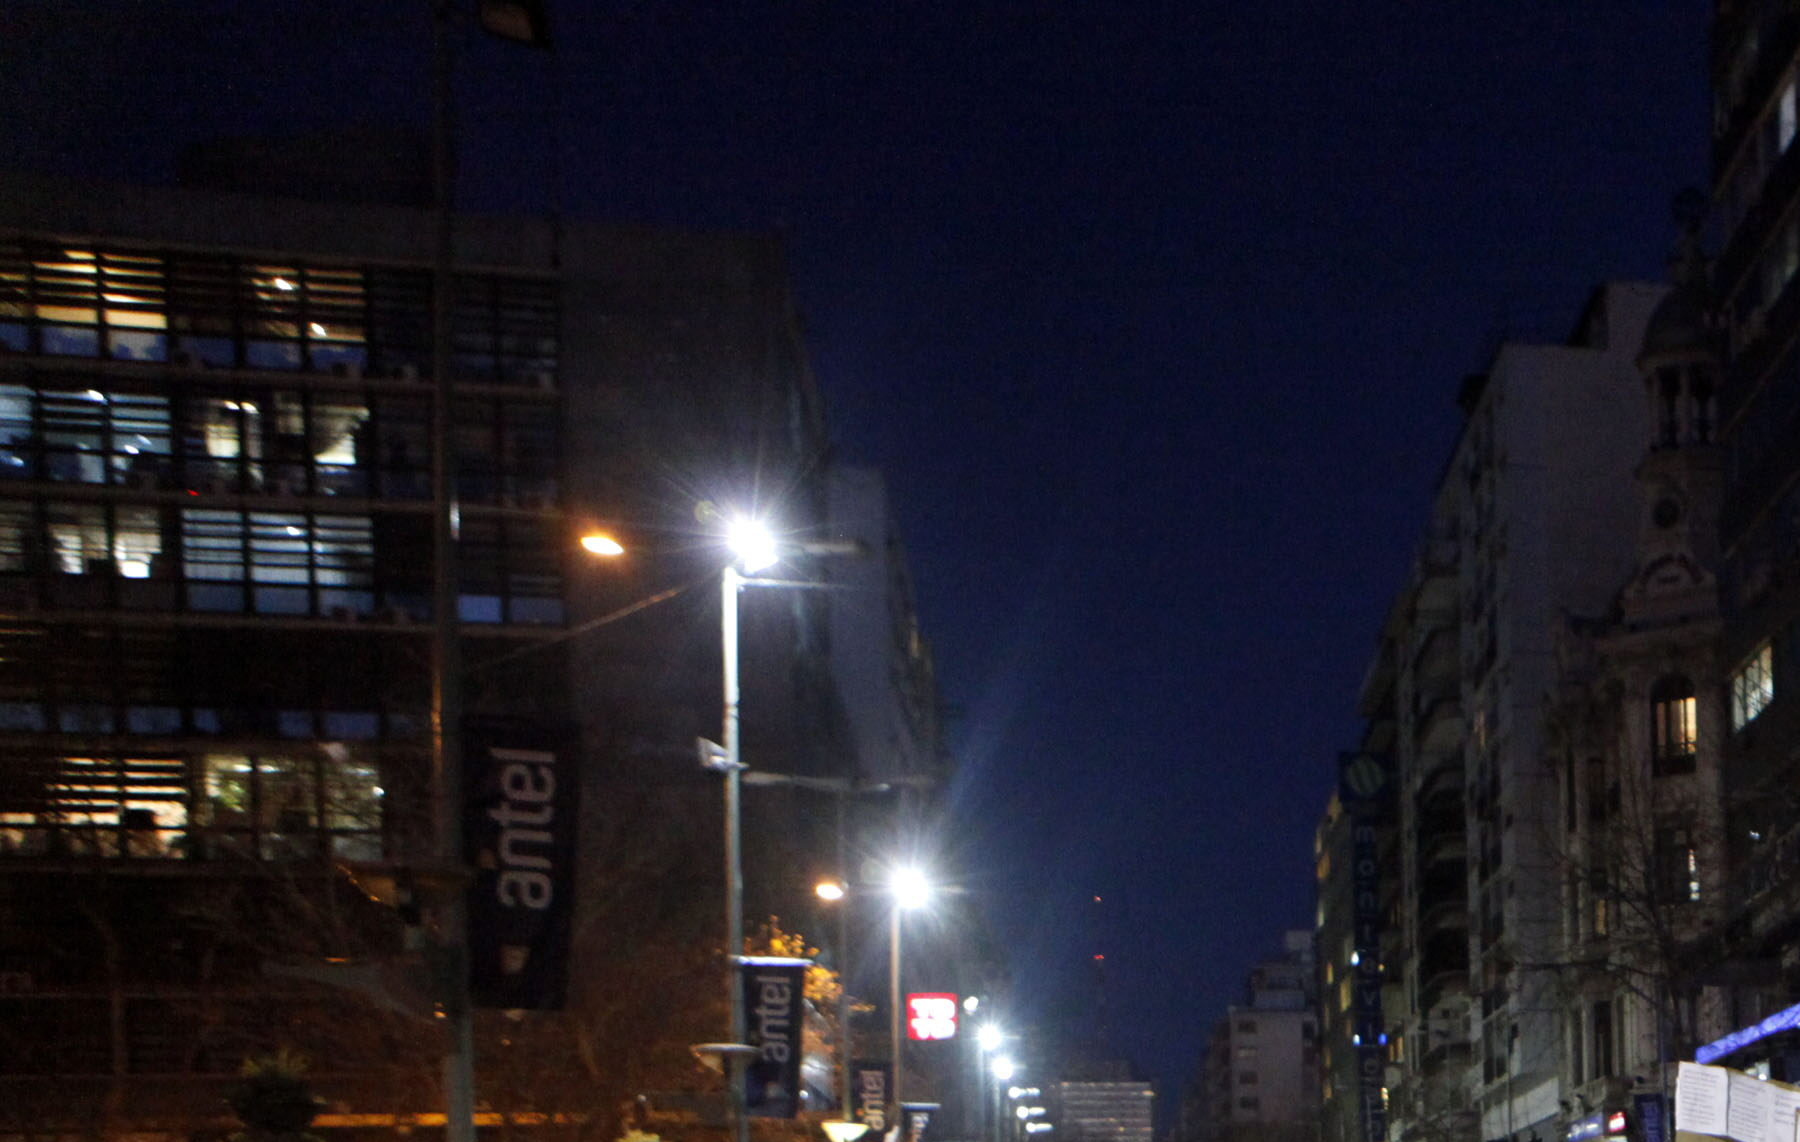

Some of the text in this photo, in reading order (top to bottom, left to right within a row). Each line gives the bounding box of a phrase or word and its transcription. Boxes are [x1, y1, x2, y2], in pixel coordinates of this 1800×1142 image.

[496, 747, 557, 911] antel
[760, 974, 793, 1067] antel
[860, 1069, 886, 1132] antel
